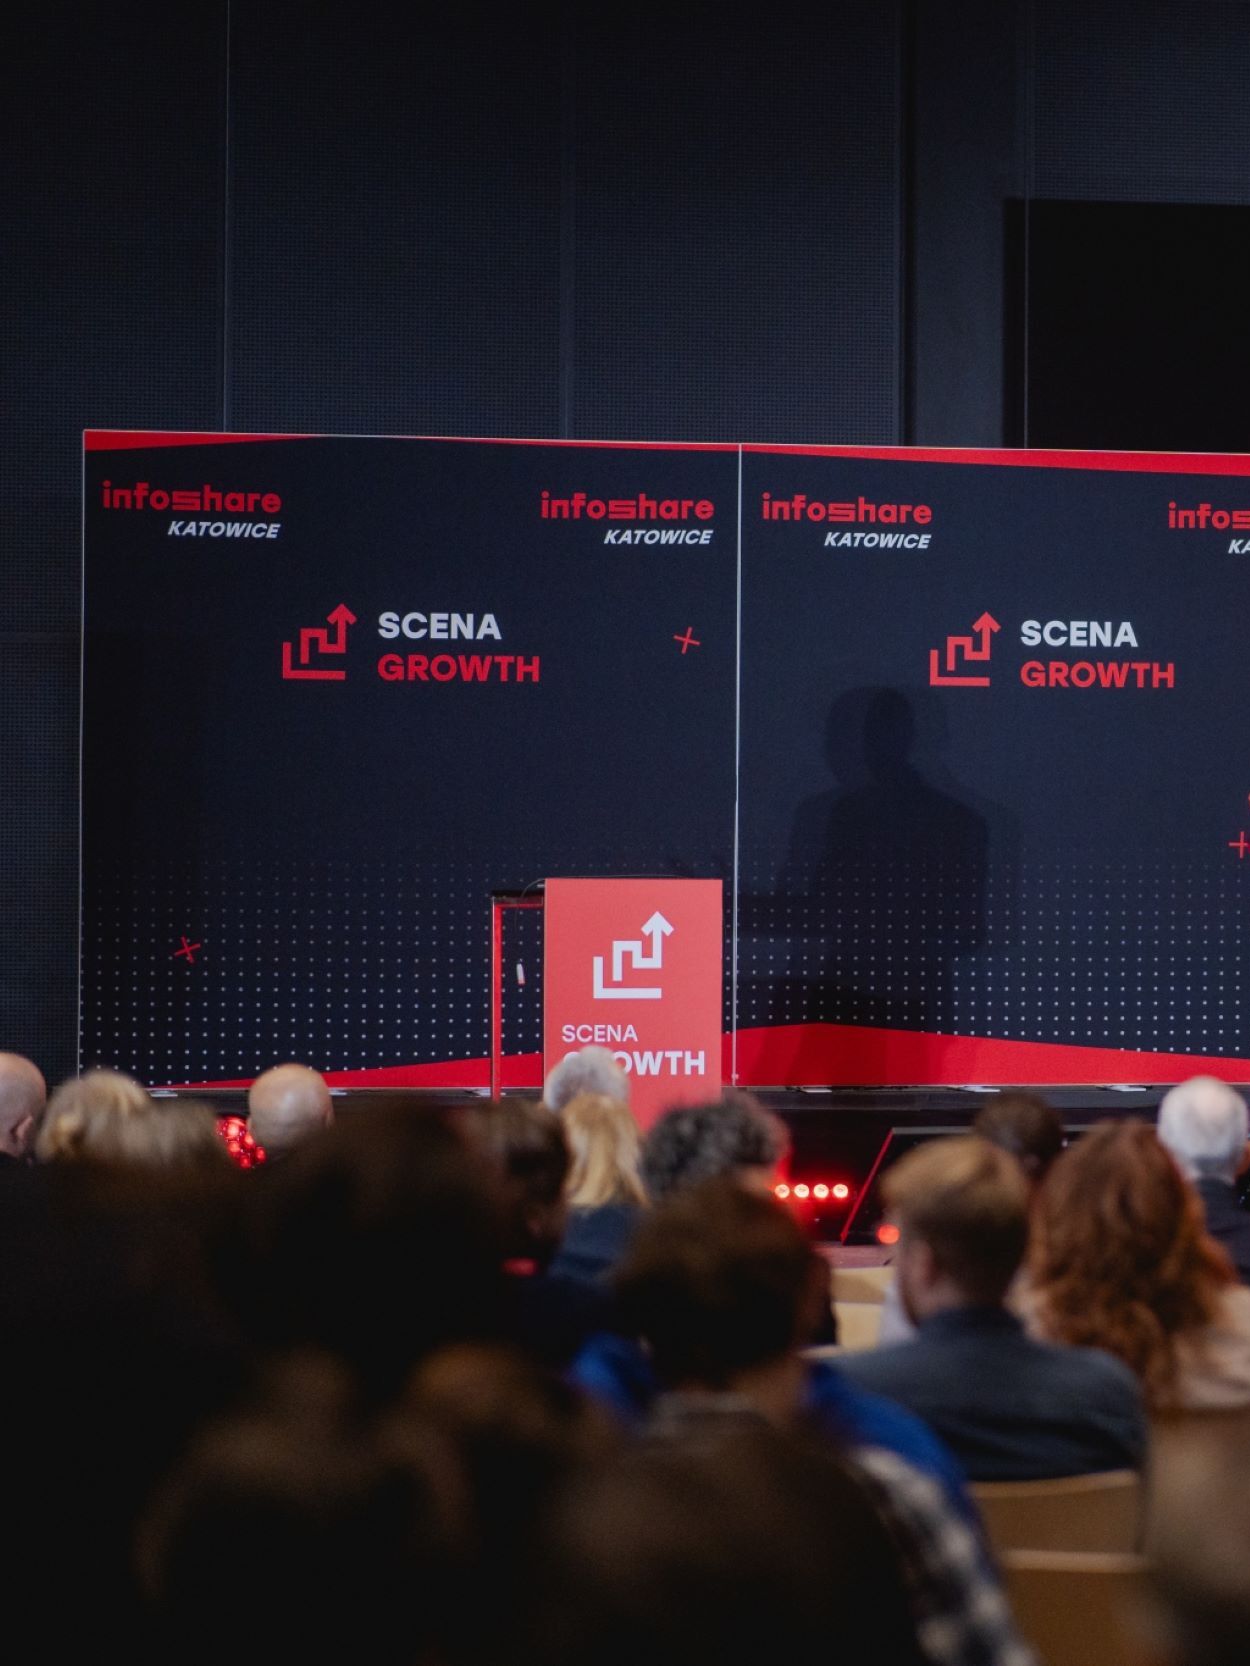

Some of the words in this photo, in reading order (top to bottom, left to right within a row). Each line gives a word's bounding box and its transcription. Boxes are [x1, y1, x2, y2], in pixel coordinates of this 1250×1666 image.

[102, 480, 282, 513] infoshare
[540, 490, 715, 520] infoshare
[762, 492, 933, 524] infoshare
[167, 520, 281, 539] KATOWICE
[603, 529, 714, 545] KATOWICE
[823, 531, 932, 549] KATOWICE
[377, 612, 502, 640] SCENA
[1020, 620, 1139, 648] SCENA
[377, 653, 541, 683] GROWTH
[1020, 661, 1175, 689] GROWTH
[561, 1024, 639, 1043] SCENA
[563, 1050, 705, 1076] OWTH
